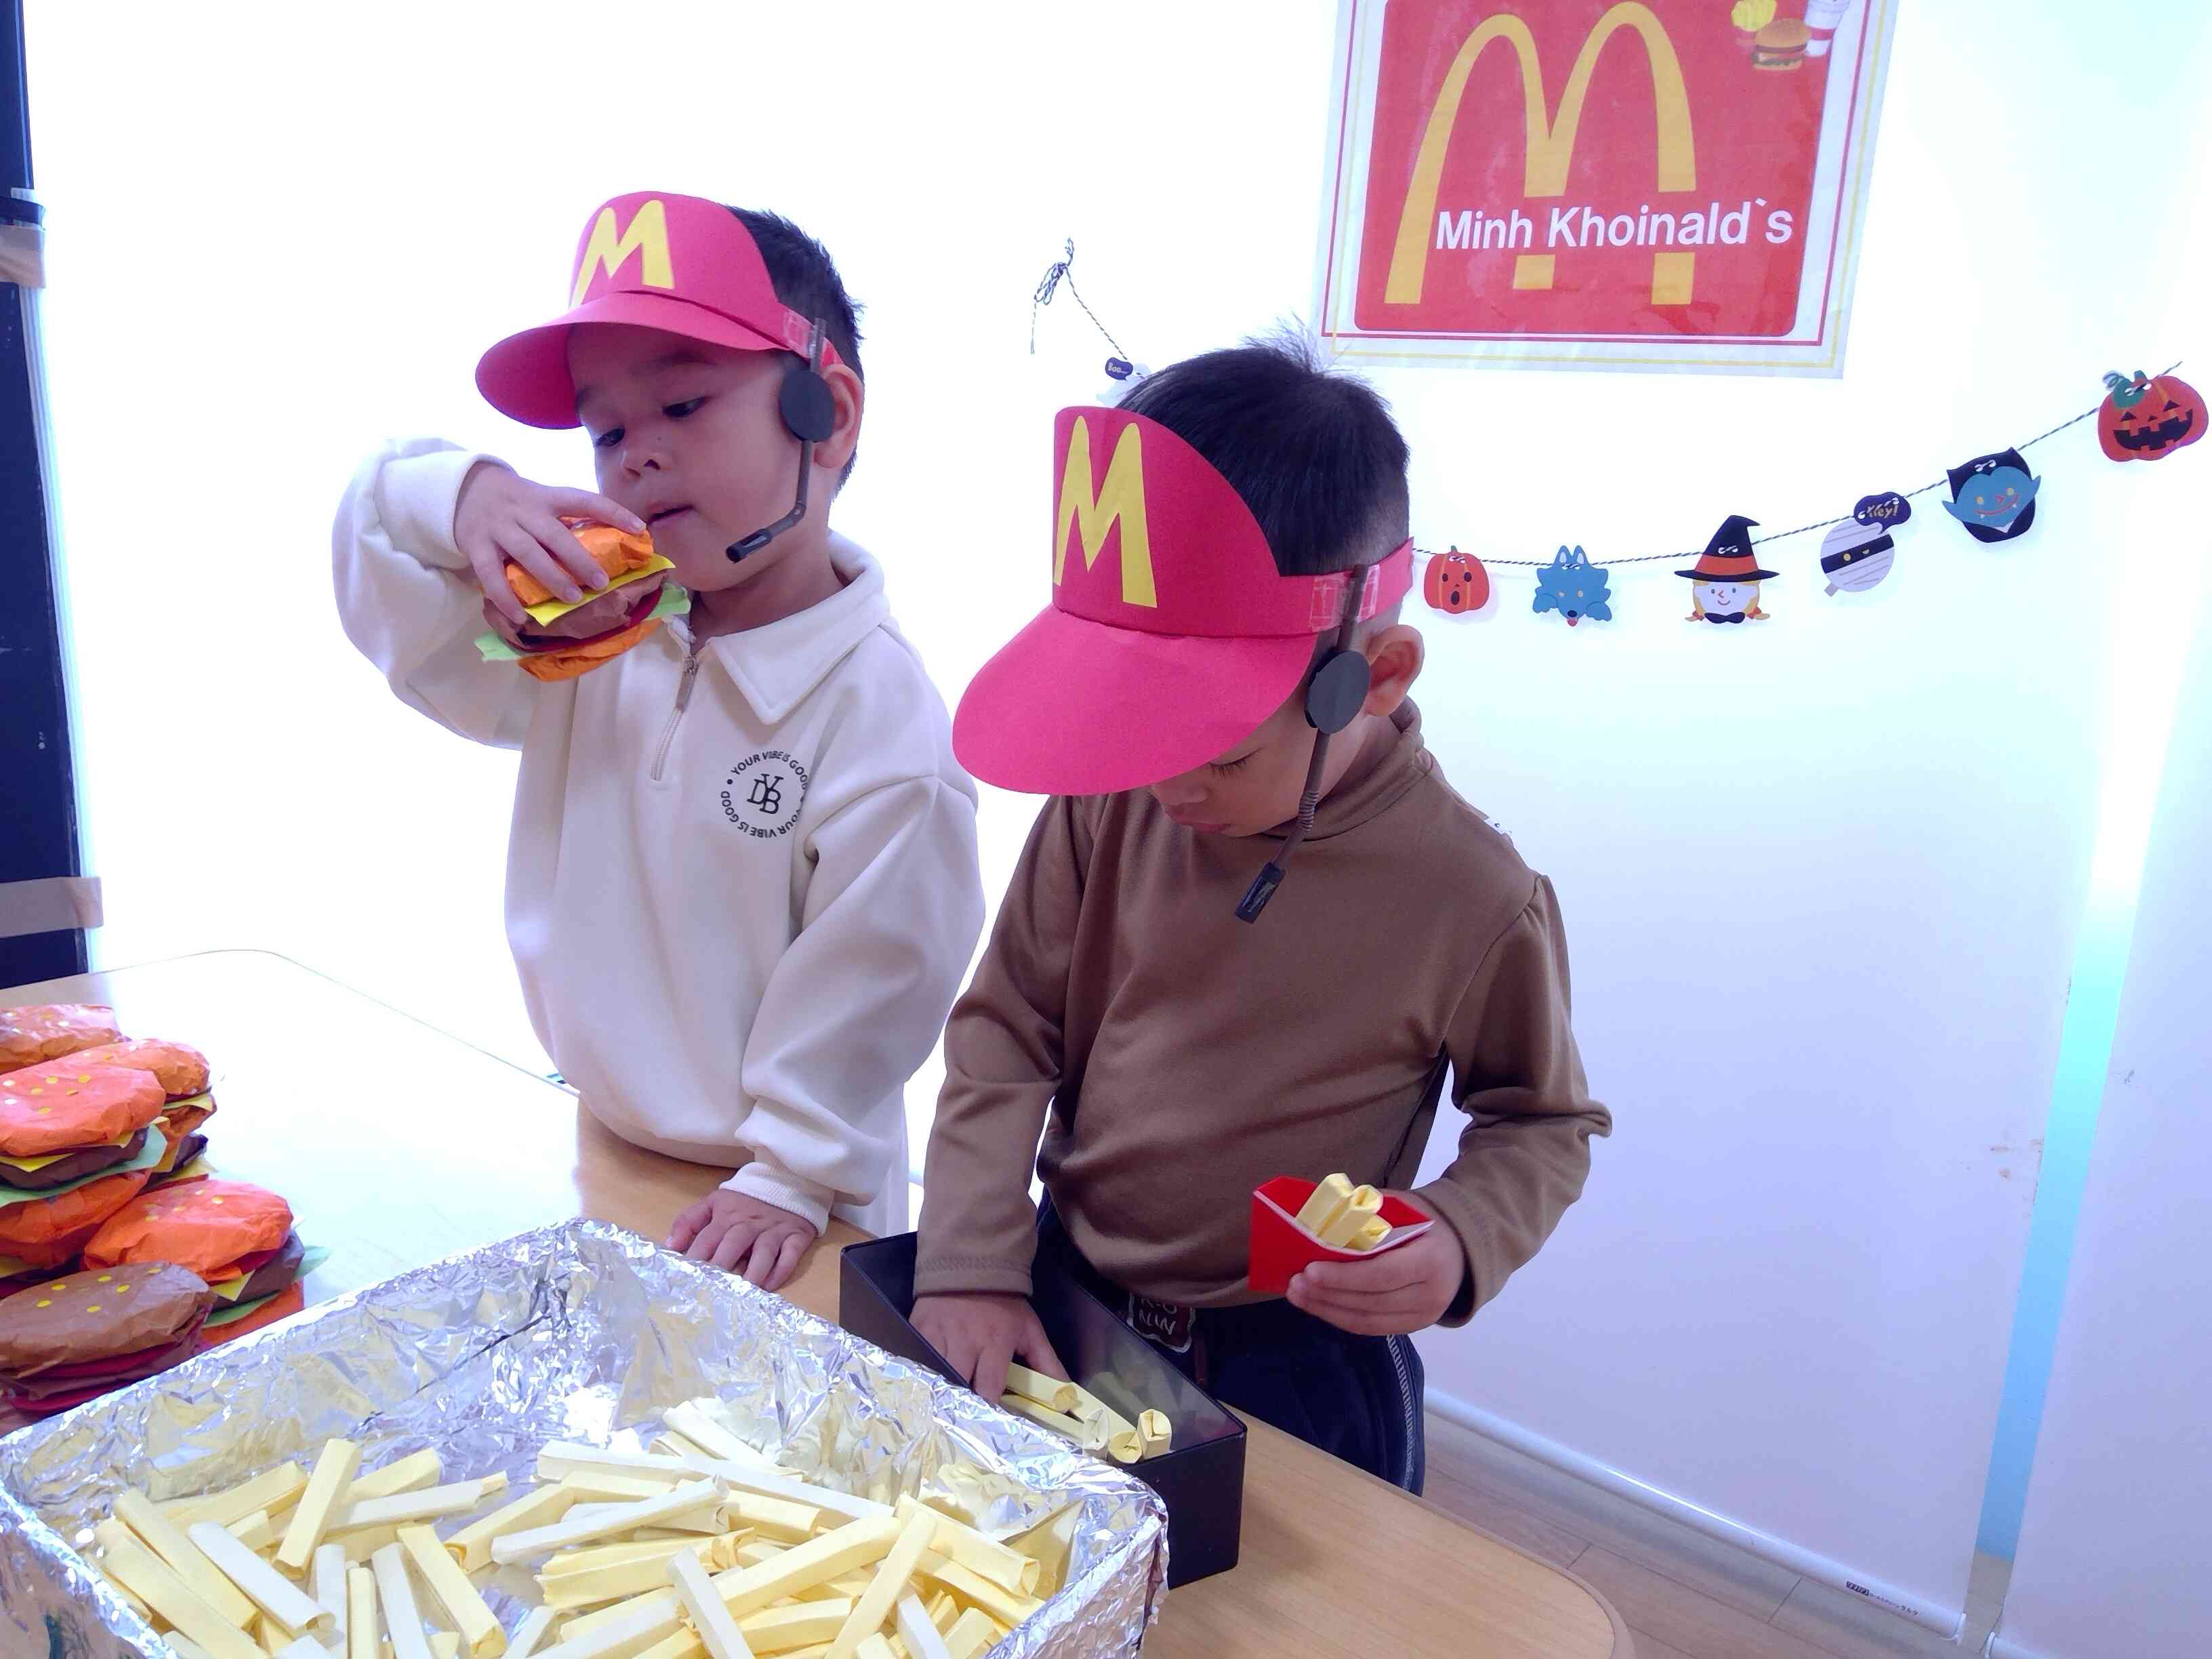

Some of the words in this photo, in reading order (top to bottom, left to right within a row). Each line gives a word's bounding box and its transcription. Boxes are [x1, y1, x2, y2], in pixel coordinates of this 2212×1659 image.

[1436, 209, 1534, 249] Minh
[569, 200, 674, 308] M
[1053, 415, 1157, 608] M
[731, 754, 760, 775] YOUR
[720, 791, 739, 823] GOOD
[737, 821, 750, 833] IS
[749, 827, 777, 838] VIBE
